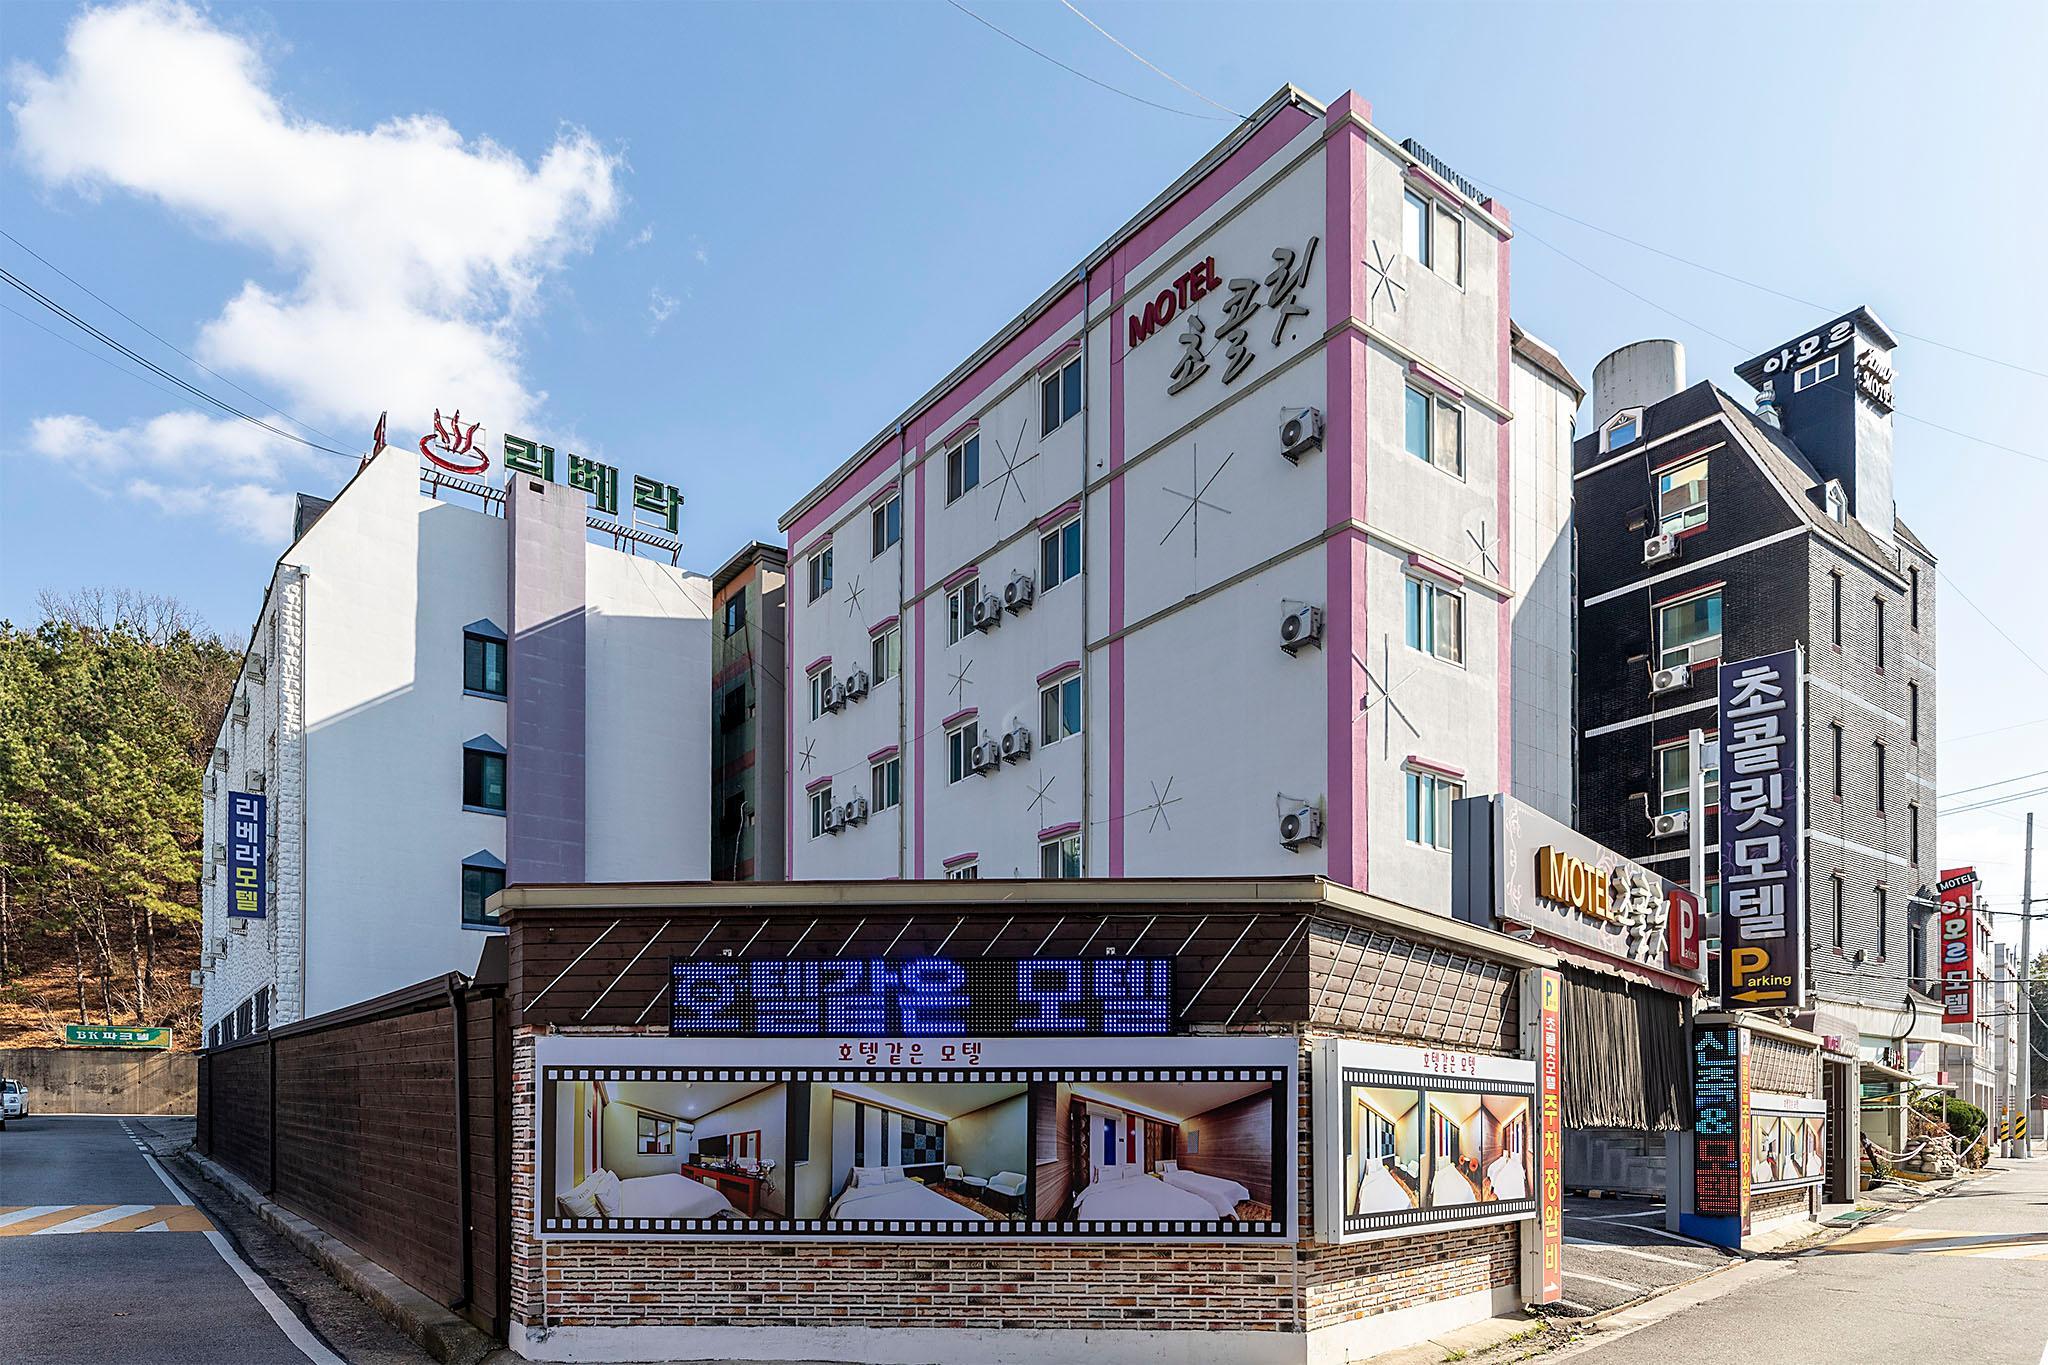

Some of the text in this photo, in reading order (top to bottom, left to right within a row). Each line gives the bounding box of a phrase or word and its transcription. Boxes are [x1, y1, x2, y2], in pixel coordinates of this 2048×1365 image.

[1129, 255, 1222, 348] MOTEL
[1167, 236, 1319, 396] 초콜릿
[1763, 320, 1856, 373] 아모르
[504, 433, 684, 534] 리베라
[1726, 665, 1788, 940] 초콜릿모텔
[235, 798, 260, 912] 리베라모텔
[1538, 845, 1614, 923] MOTEL
[1939, 873, 1975, 891] MOTEL
[1731, 947, 1792, 987] Parking
[1941, 895, 1973, 1015] 아모르 모텔
[76, 1031, 98, 1040] BK
[1014, 960, 1169, 1033] 모텔
[838, 1041, 983, 1065] 호텔같은 모텔
[1424, 1052, 1476, 1075] 호텔같은 모텔
[1544, 1094, 1560, 1274] 주차장완비
